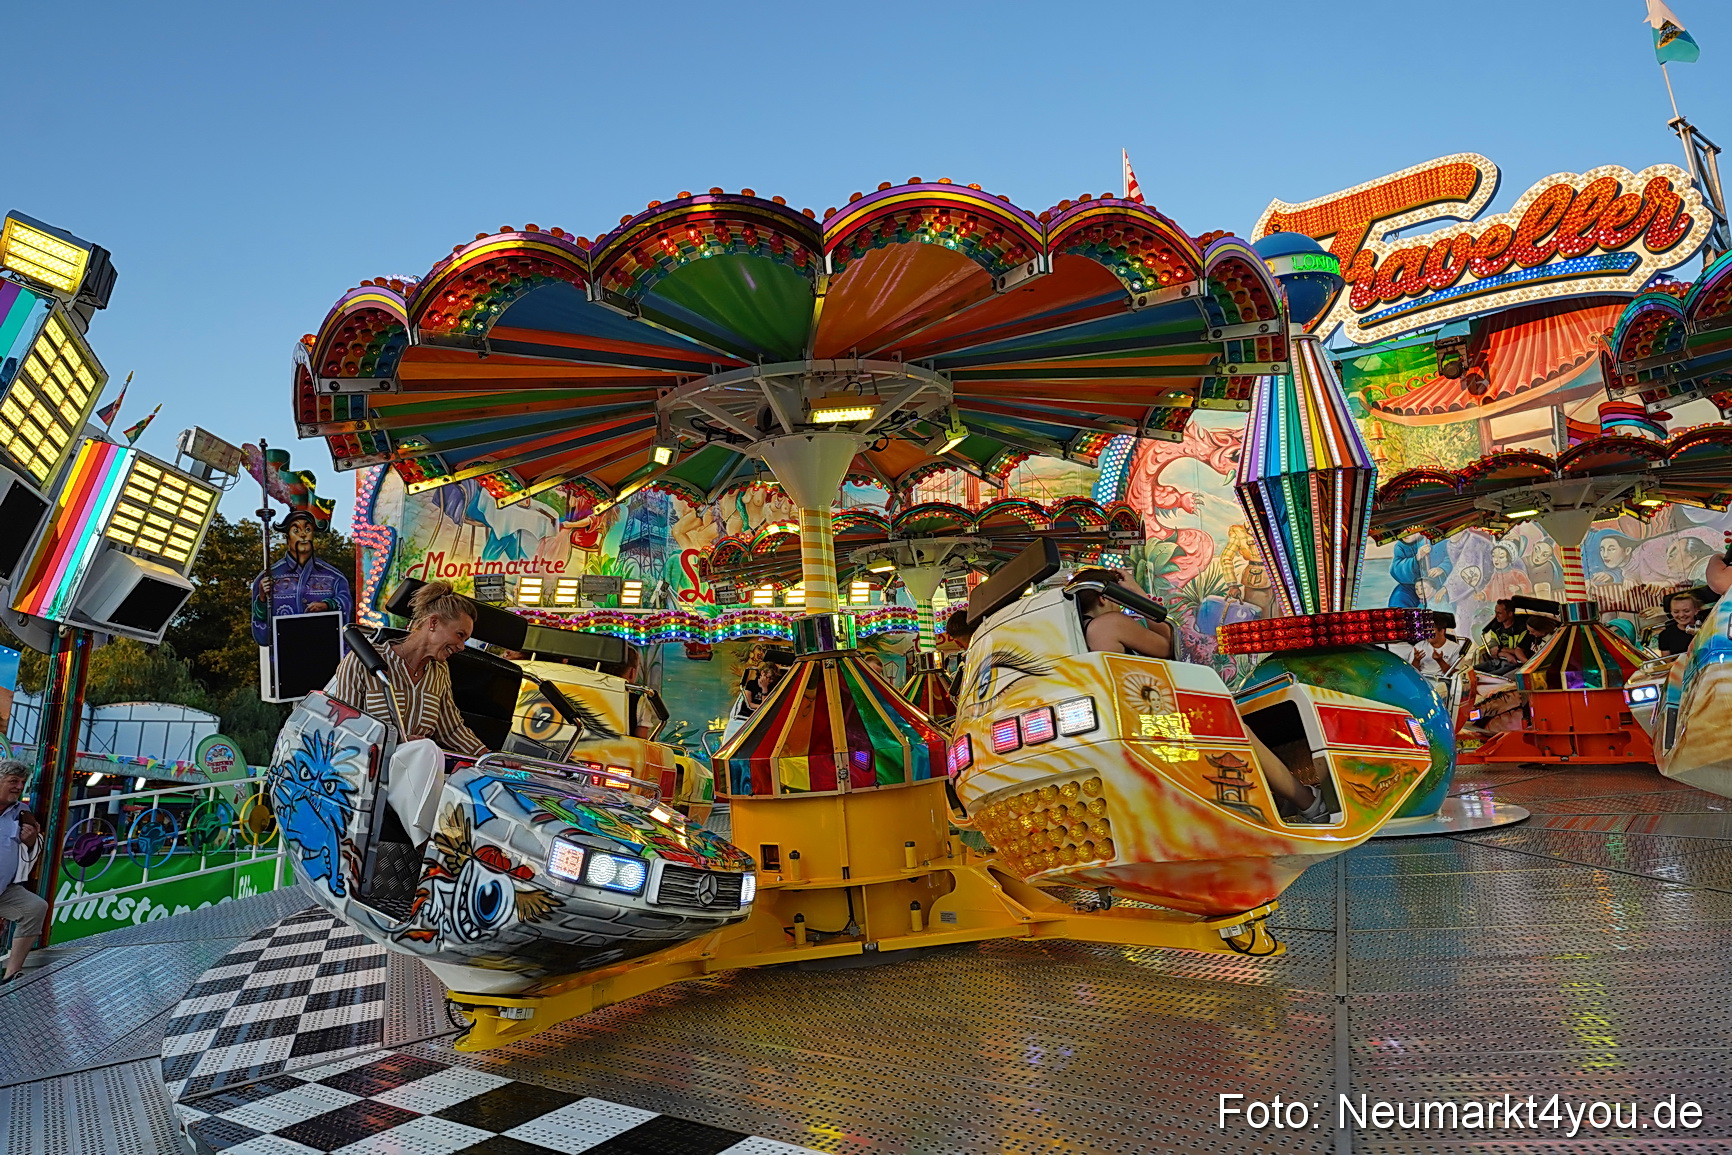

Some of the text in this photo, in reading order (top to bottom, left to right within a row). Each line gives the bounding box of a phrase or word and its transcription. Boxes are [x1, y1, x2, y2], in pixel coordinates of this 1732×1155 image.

[1262, 160, 1693, 333] Traveller
[405, 551, 566, 582] Montmartre
[538, 712, 551, 728] 7
